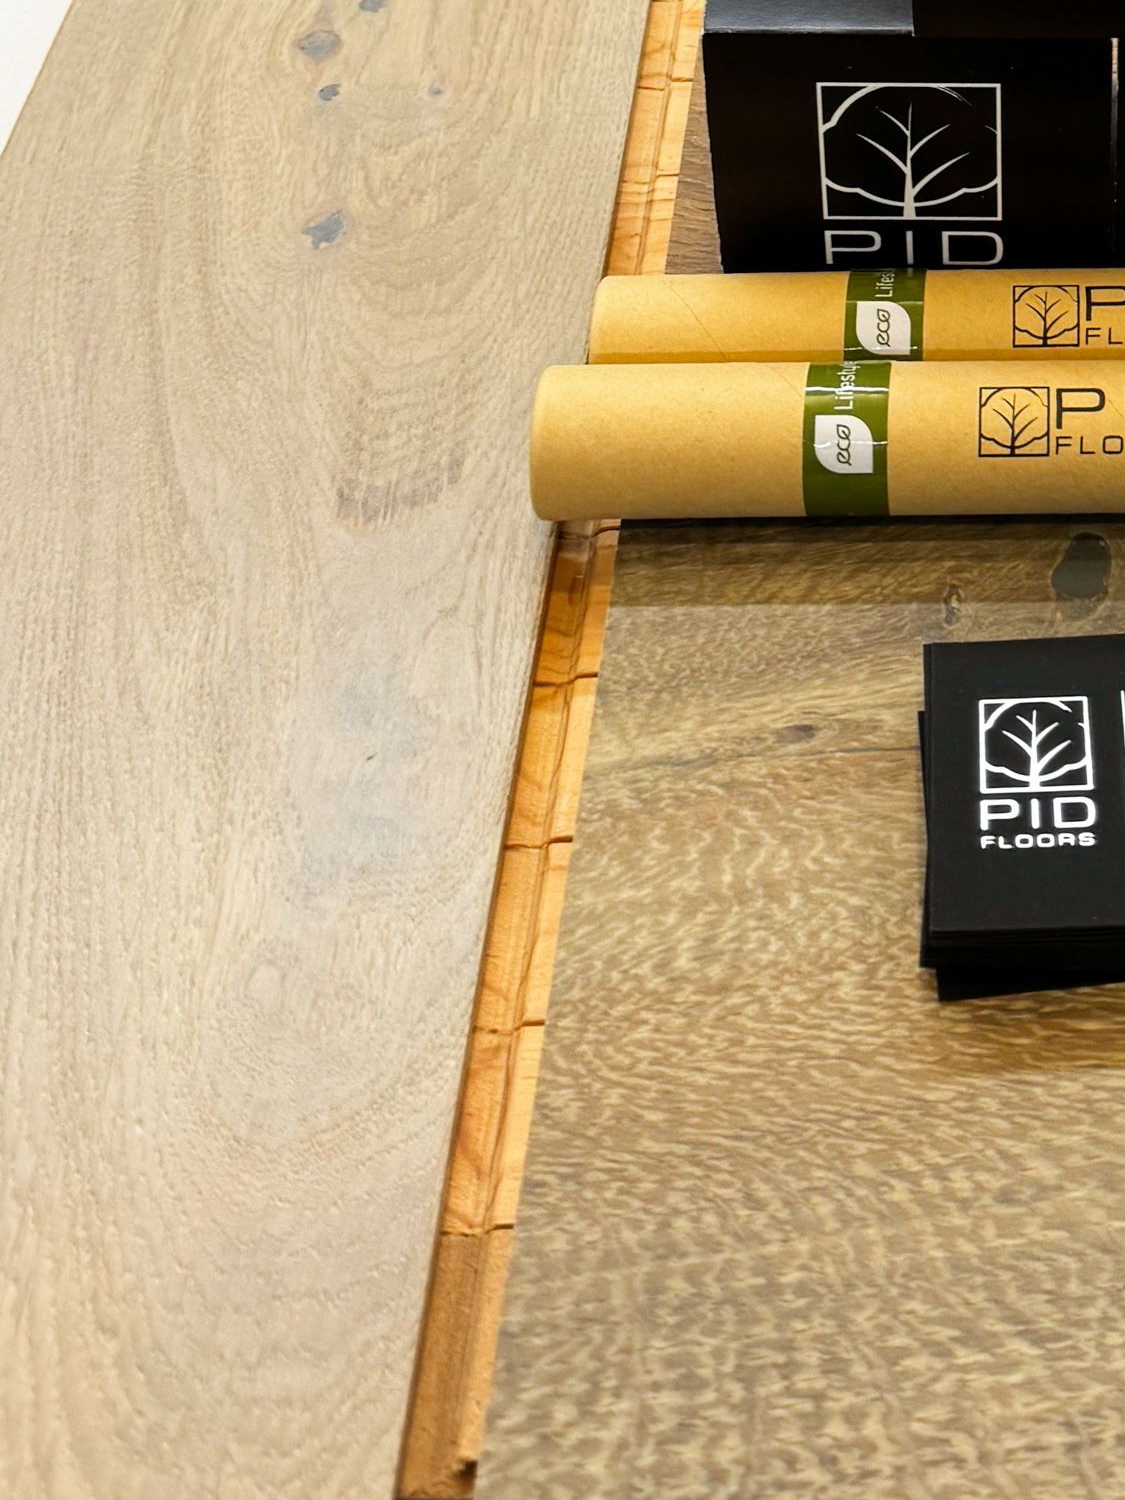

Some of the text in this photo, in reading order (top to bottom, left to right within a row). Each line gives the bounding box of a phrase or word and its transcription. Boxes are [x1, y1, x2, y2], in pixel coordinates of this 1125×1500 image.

[824, 230, 1004, 265] PID
[980, 796, 1096, 831] PID
[980, 832, 1096, 849] FLOORS
